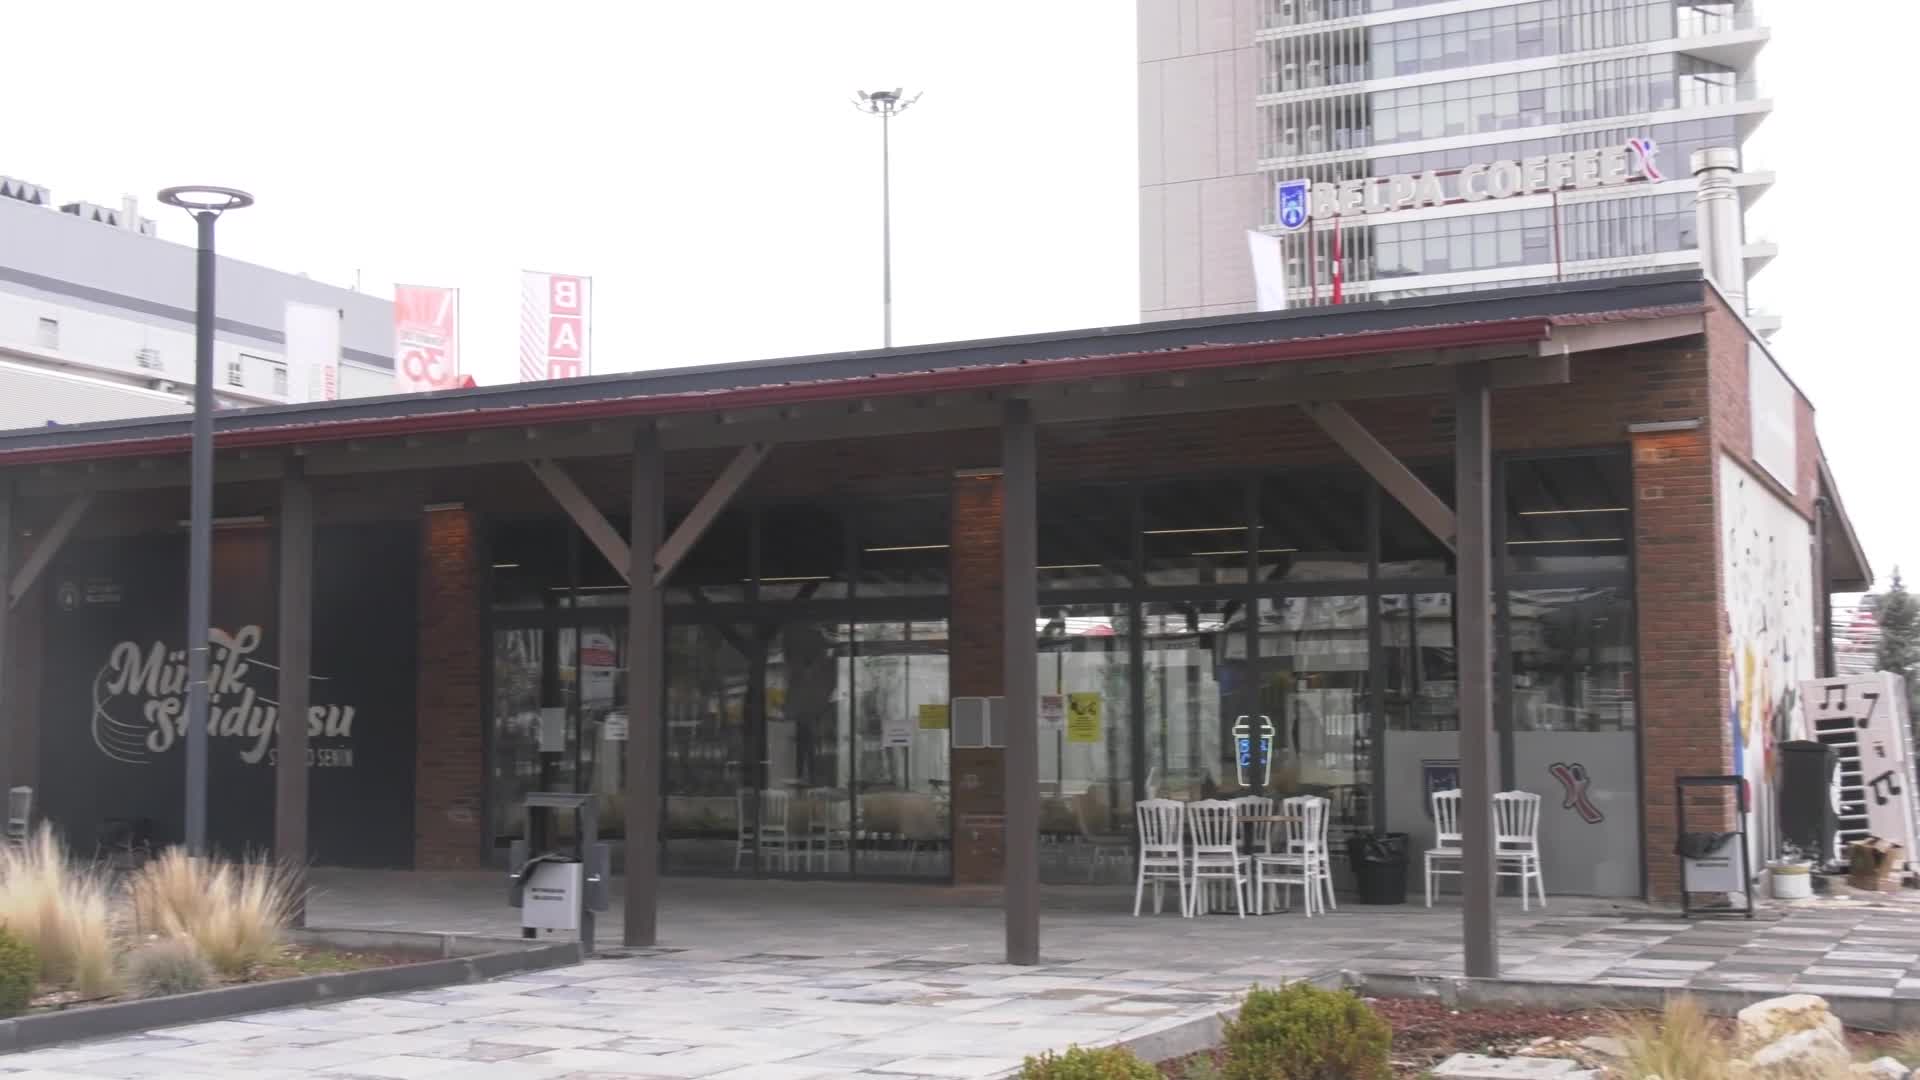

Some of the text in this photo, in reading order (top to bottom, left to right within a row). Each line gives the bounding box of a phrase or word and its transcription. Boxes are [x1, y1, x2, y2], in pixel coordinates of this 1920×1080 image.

[1311, 146, 1628, 219] BELPA COFFEE
[106, 625, 262, 697] Müik
